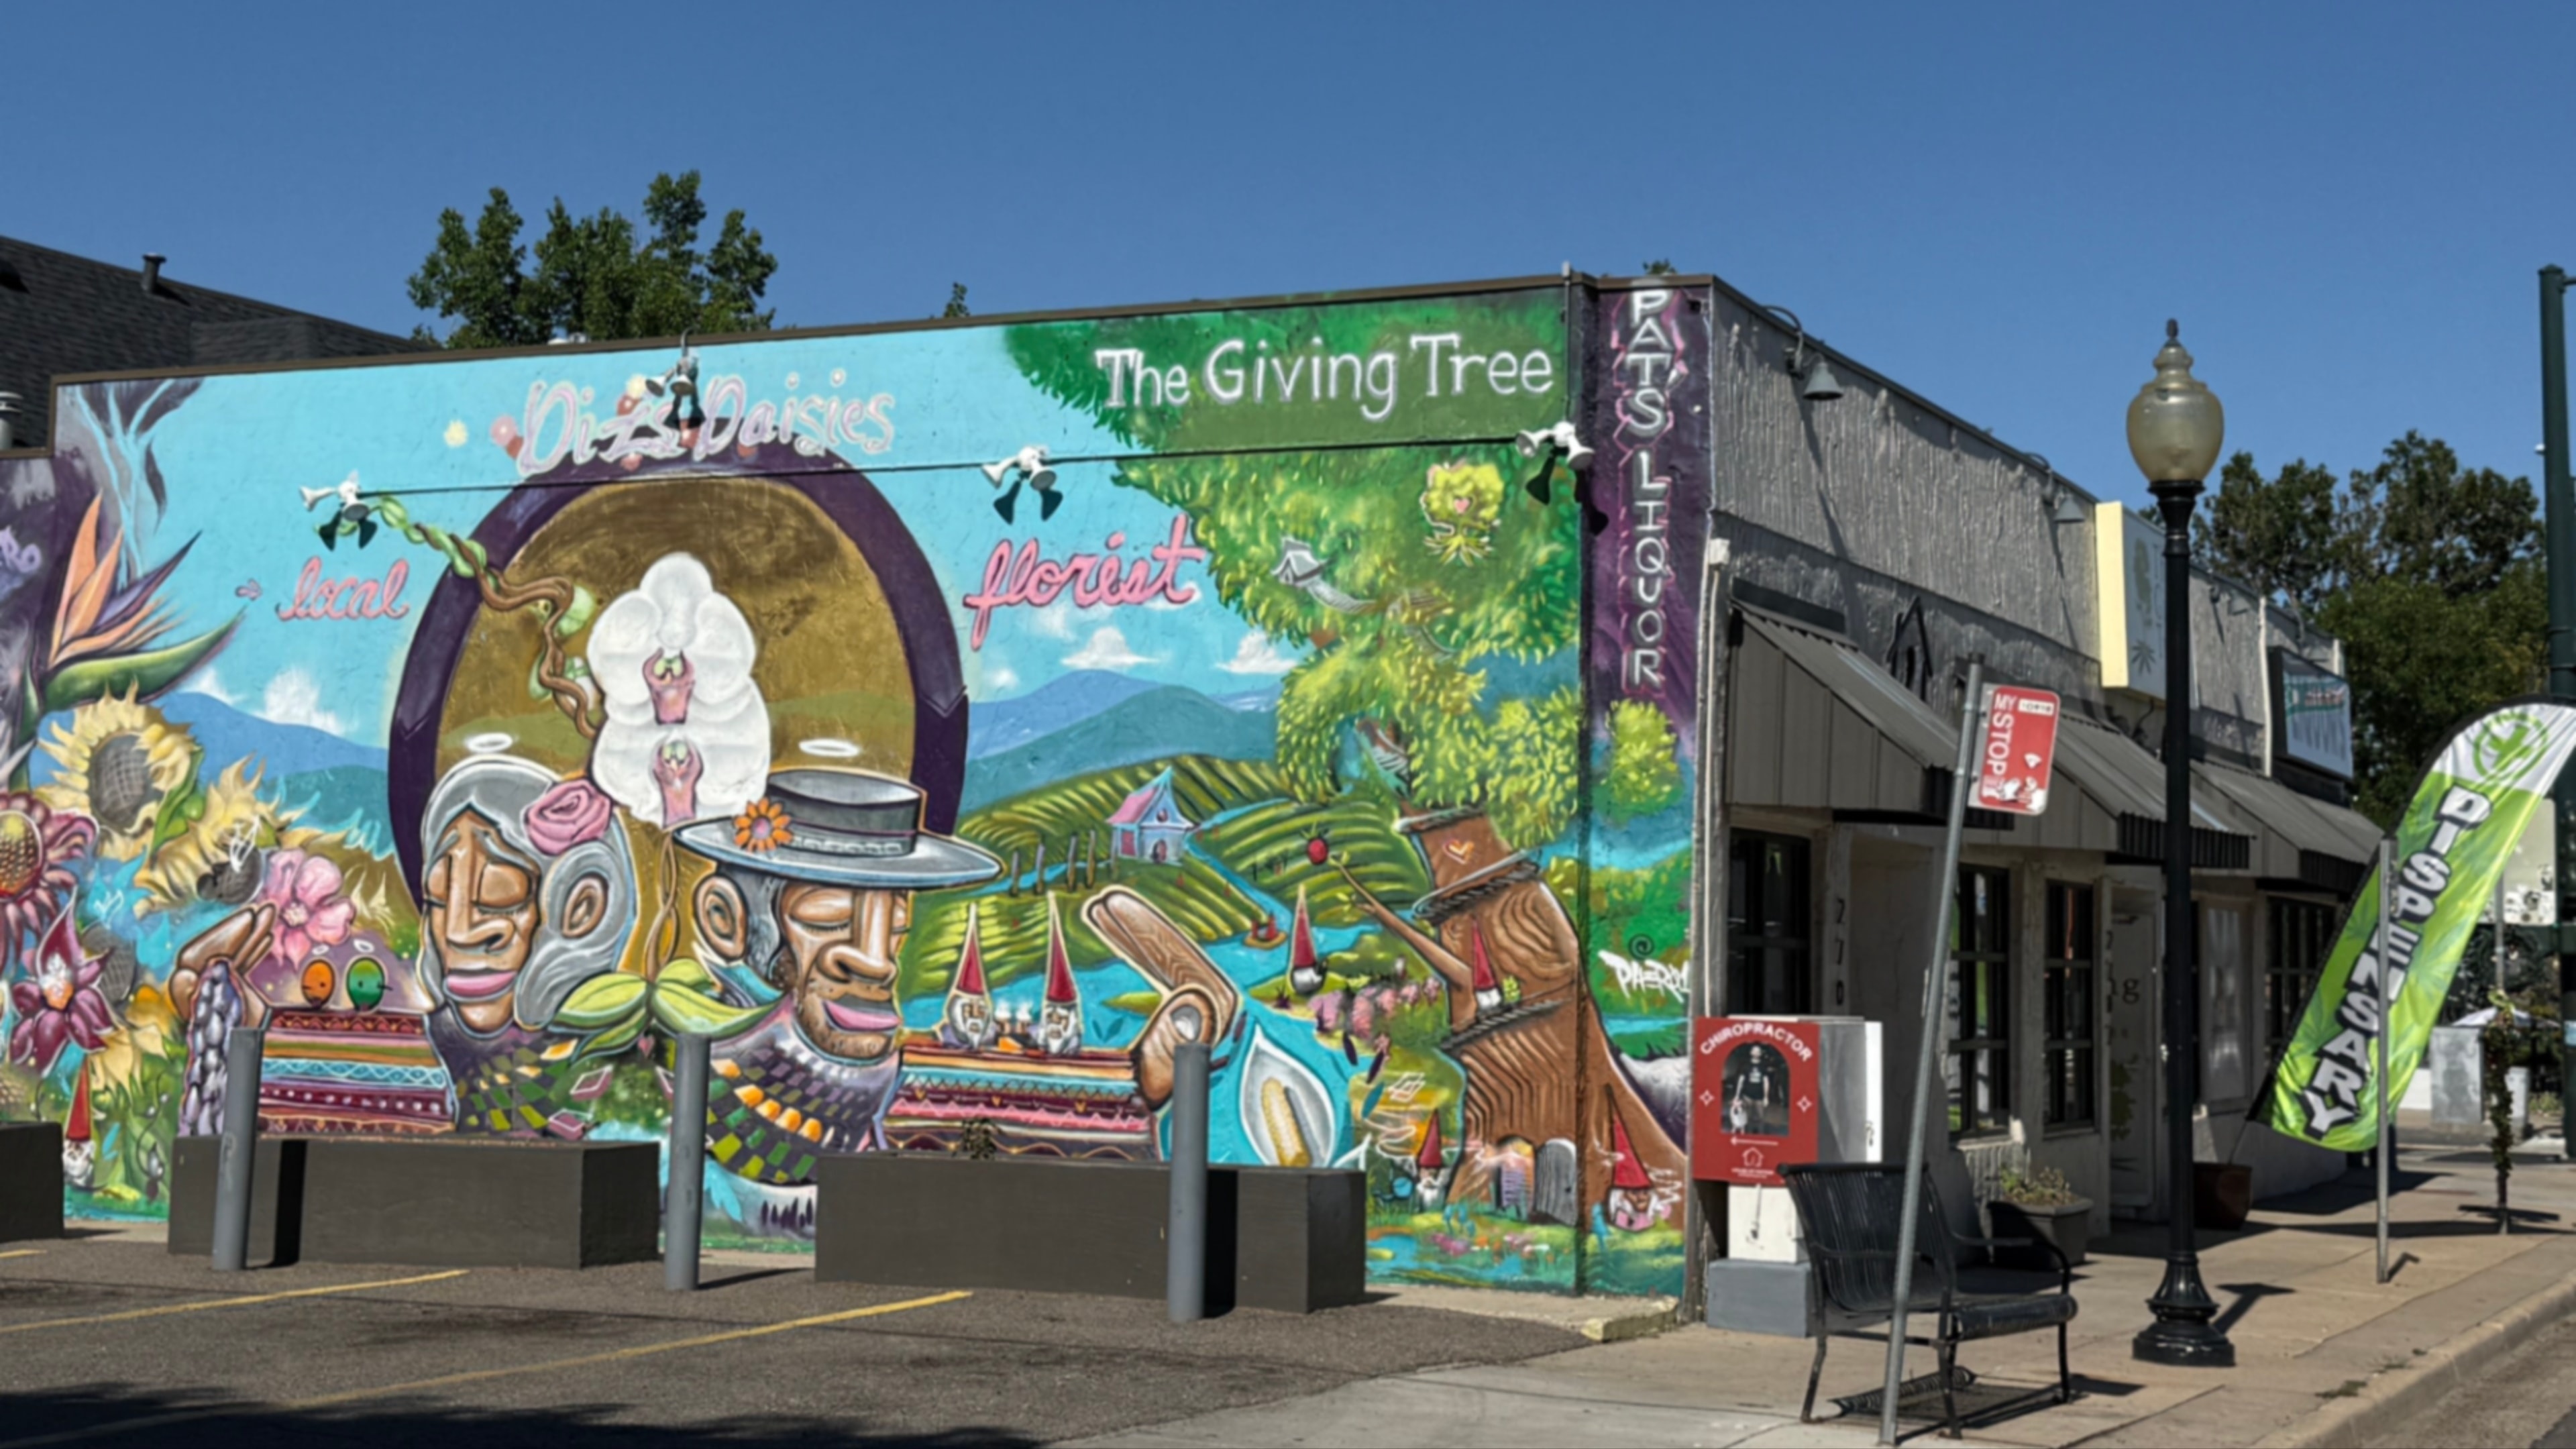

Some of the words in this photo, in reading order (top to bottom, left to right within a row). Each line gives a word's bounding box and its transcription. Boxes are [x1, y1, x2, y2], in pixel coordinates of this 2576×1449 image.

[692, 368, 896, 462] Daisies
[1095, 347, 1190, 408] The
[1205, 337, 1397, 421] Giving
[1409, 333, 1554, 398] Tree
[274, 555, 411, 621] local
[962, 511, 1206, 653] florist
[1634, 449, 1670, 687] LIQUOR
[1986, 712, 2015, 776] STOP
[2305, 785, 2493, 1138] DISPENSARY
[1700, 1022, 1813, 1063] CHIROPRACTOR
